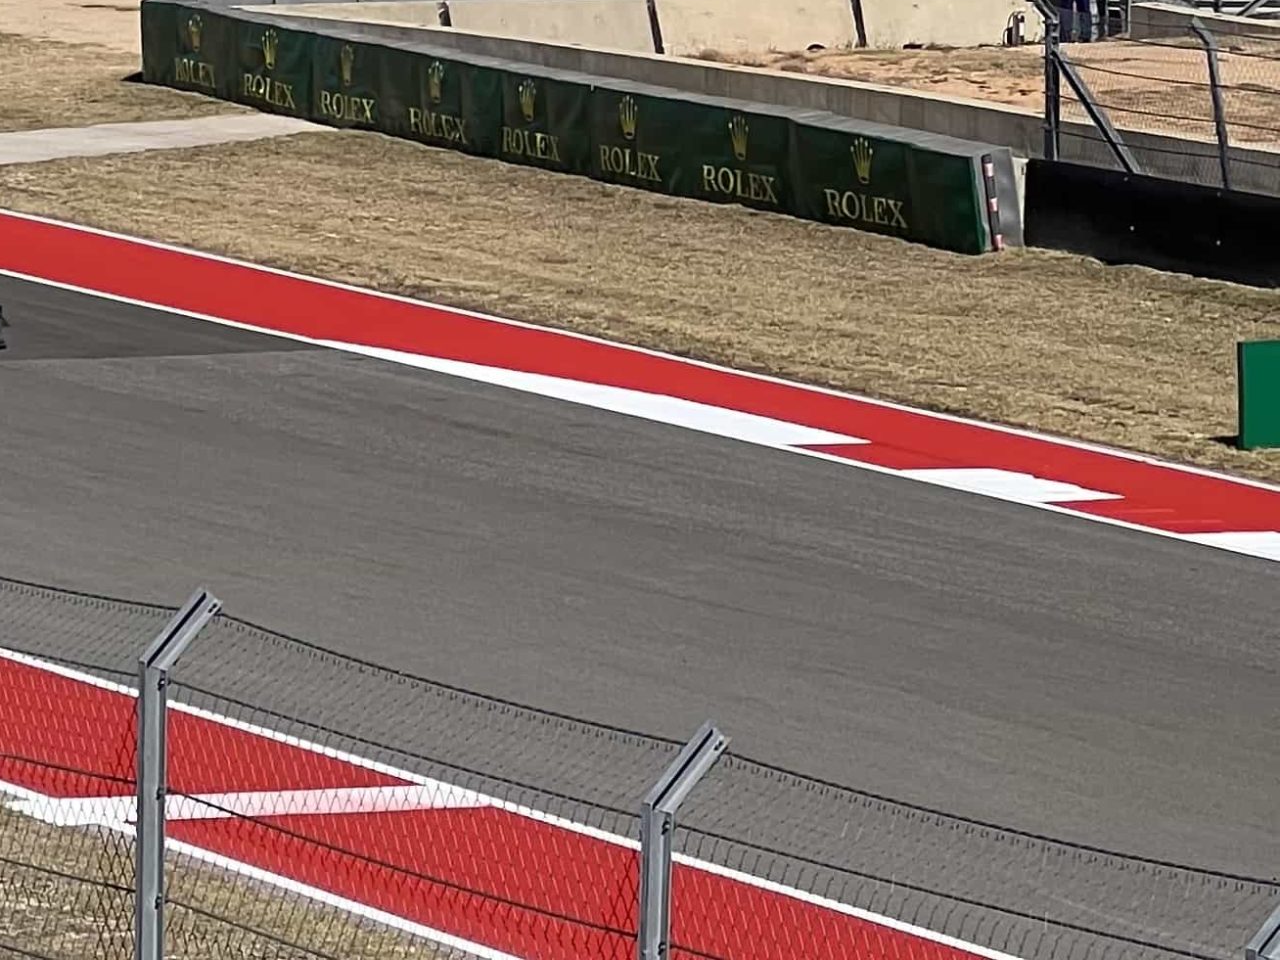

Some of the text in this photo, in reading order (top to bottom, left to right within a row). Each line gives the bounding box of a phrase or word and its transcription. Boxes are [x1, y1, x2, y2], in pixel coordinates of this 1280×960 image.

[243, 73, 295, 110] ROLEX
[320, 91, 376, 124] ROLEX
[409, 107, 469, 144] ROLEX
[502, 127, 561, 162] ROLEX
[600, 144, 662, 182] ROLEX
[702, 165, 779, 202] ROLEX
[825, 189, 908, 228] ROLEX
